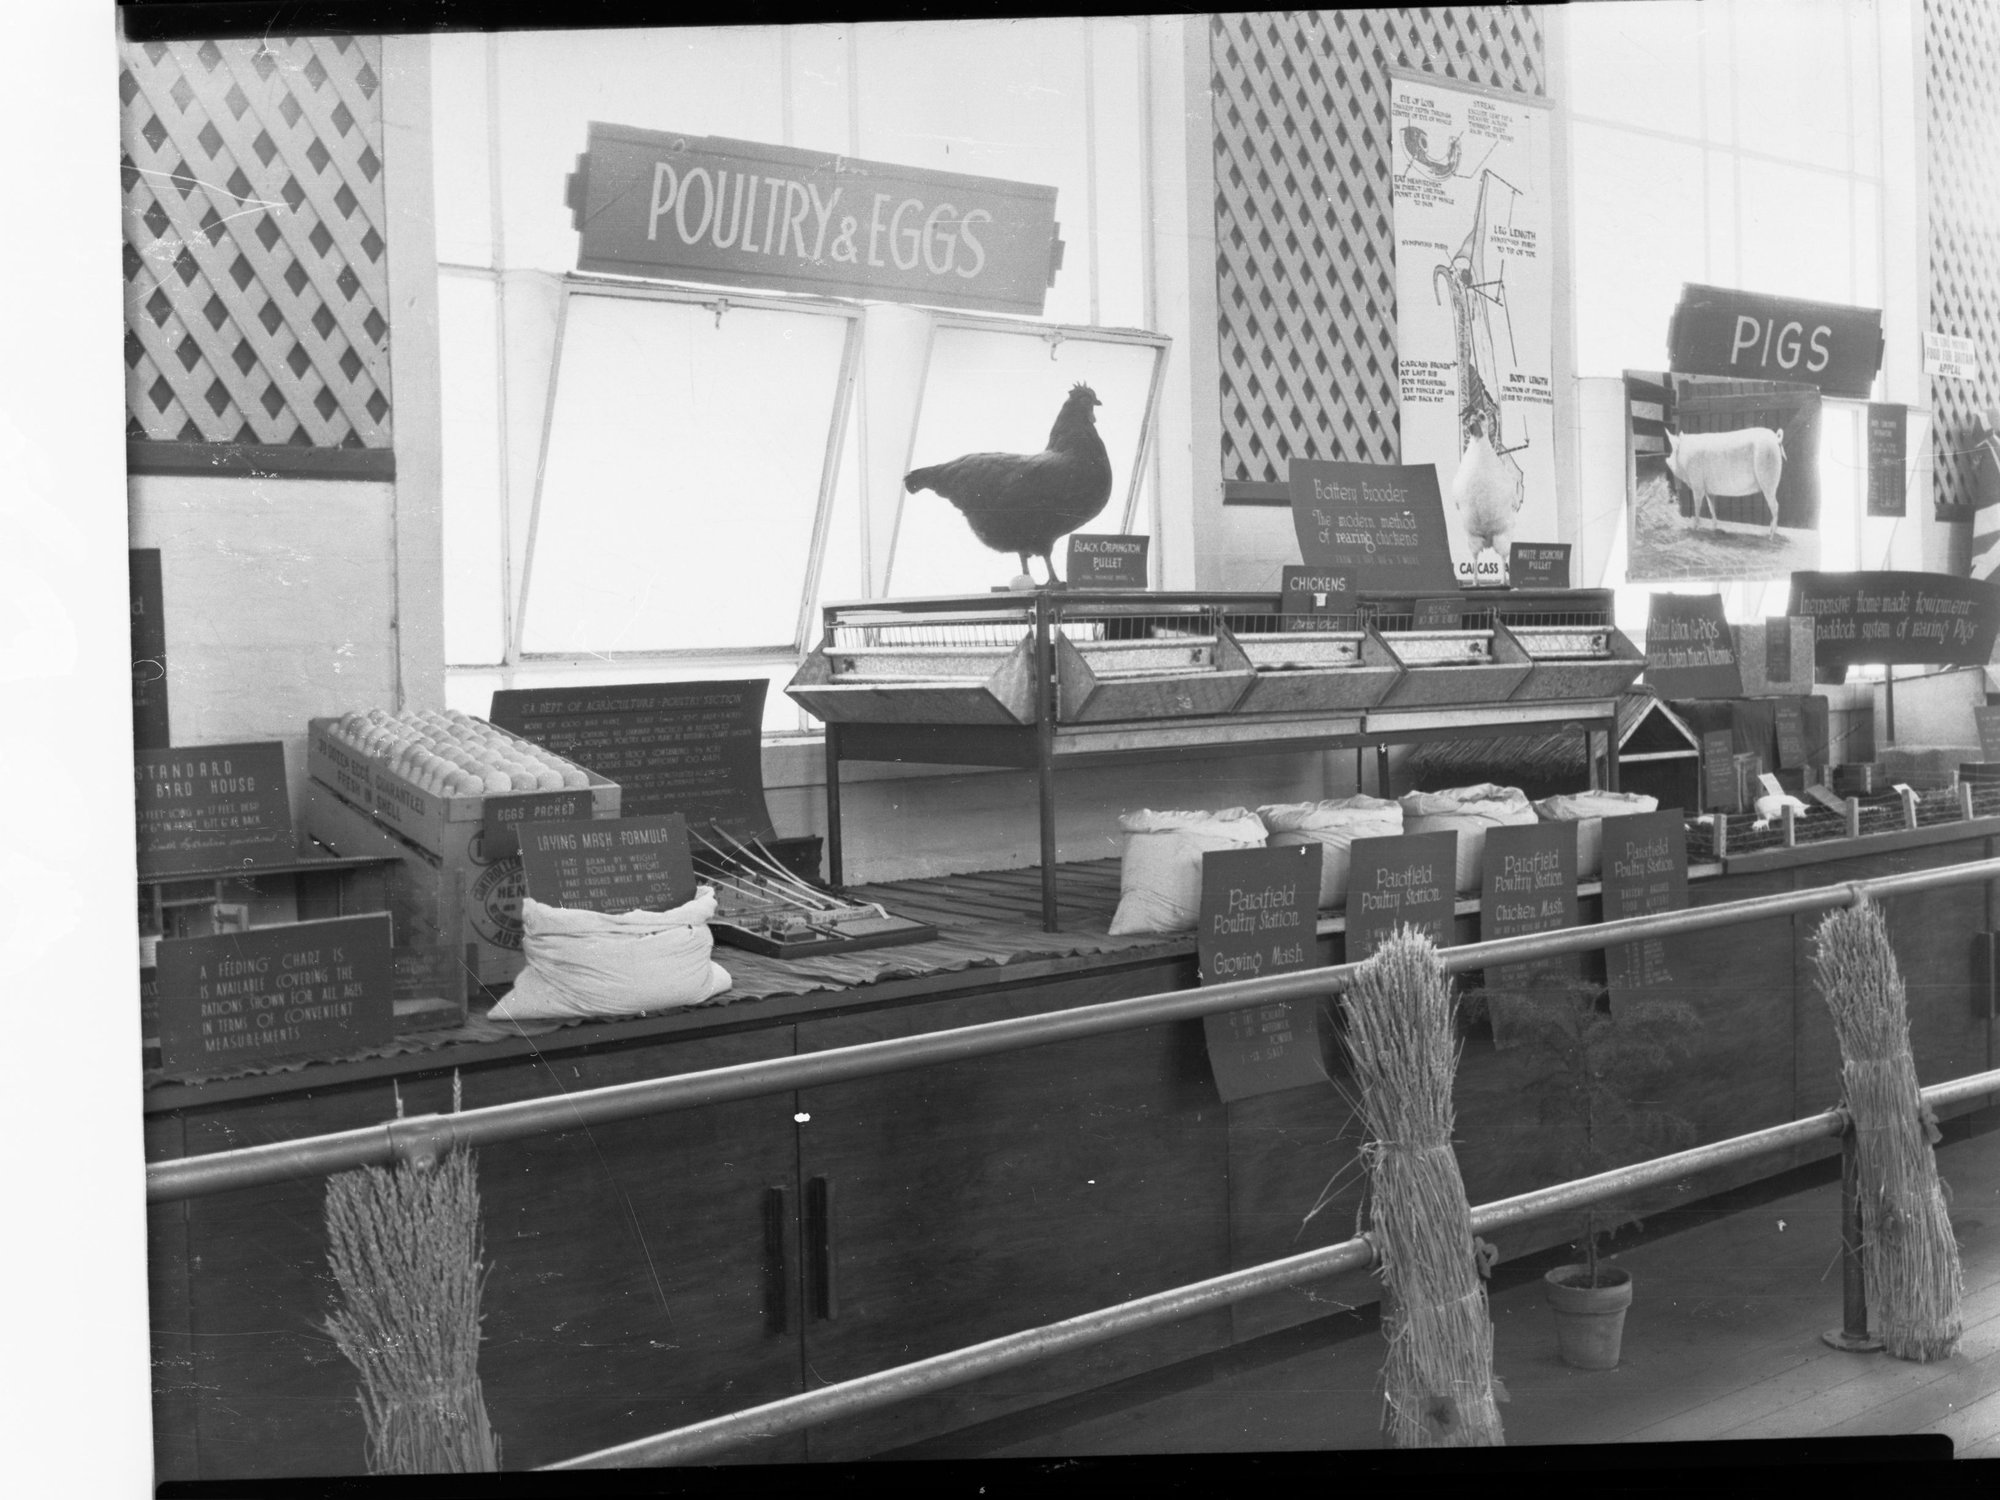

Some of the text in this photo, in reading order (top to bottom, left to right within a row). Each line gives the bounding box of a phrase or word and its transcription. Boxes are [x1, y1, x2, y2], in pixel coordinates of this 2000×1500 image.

[648, 162, 992, 278] POULTRY & EGGS
[1730, 315, 1832, 372] PIGS
[1312, 509, 1416, 529] The modern method
[1319, 528, 1330, 544] of
[1336, 531, 1376, 553] rearing
[1093, 557, 1122, 568] PULLET
[1460, 562, 1499, 574] CACASS
[1290, 576, 1346, 591] CHICKENS
[1896, 616, 1910, 640] of
[1953, 618, 1979, 645] Pigs
[704, 693, 742, 705] SECTION
[156, 776, 255, 798] BIRD HOUSE
[497, 802, 575, 821] EGGS PACKED
[538, 828, 669, 851] LAYING MASH FORMULA
[630, 853, 657, 863] WEIGHT
[633, 861, 660, 871] WEIGHT
[647, 870, 669, 881] WEIGHT
[1377, 864, 1433, 890] Parafield
[562, 889, 581, 900] MEAT
[589, 888, 608, 899] MEAL
[1229, 884, 1297, 914] Parafield
[1362, 890, 1400, 915] Poultry
[1214, 910, 1300, 935] Poultry Station
[1496, 904, 1536, 921] Chicken
[200, 947, 344, 979] A FEEDING CHART IS
[1273, 943, 1304, 966] Mash
[201, 965, 353, 999] IS AVAILABLE COVERING THE
[201, 982, 363, 1017] RATIONS SHOWN FOR ALL AGES
[203, 1001, 353, 1035] IN TERMS OF CONVENIENT
